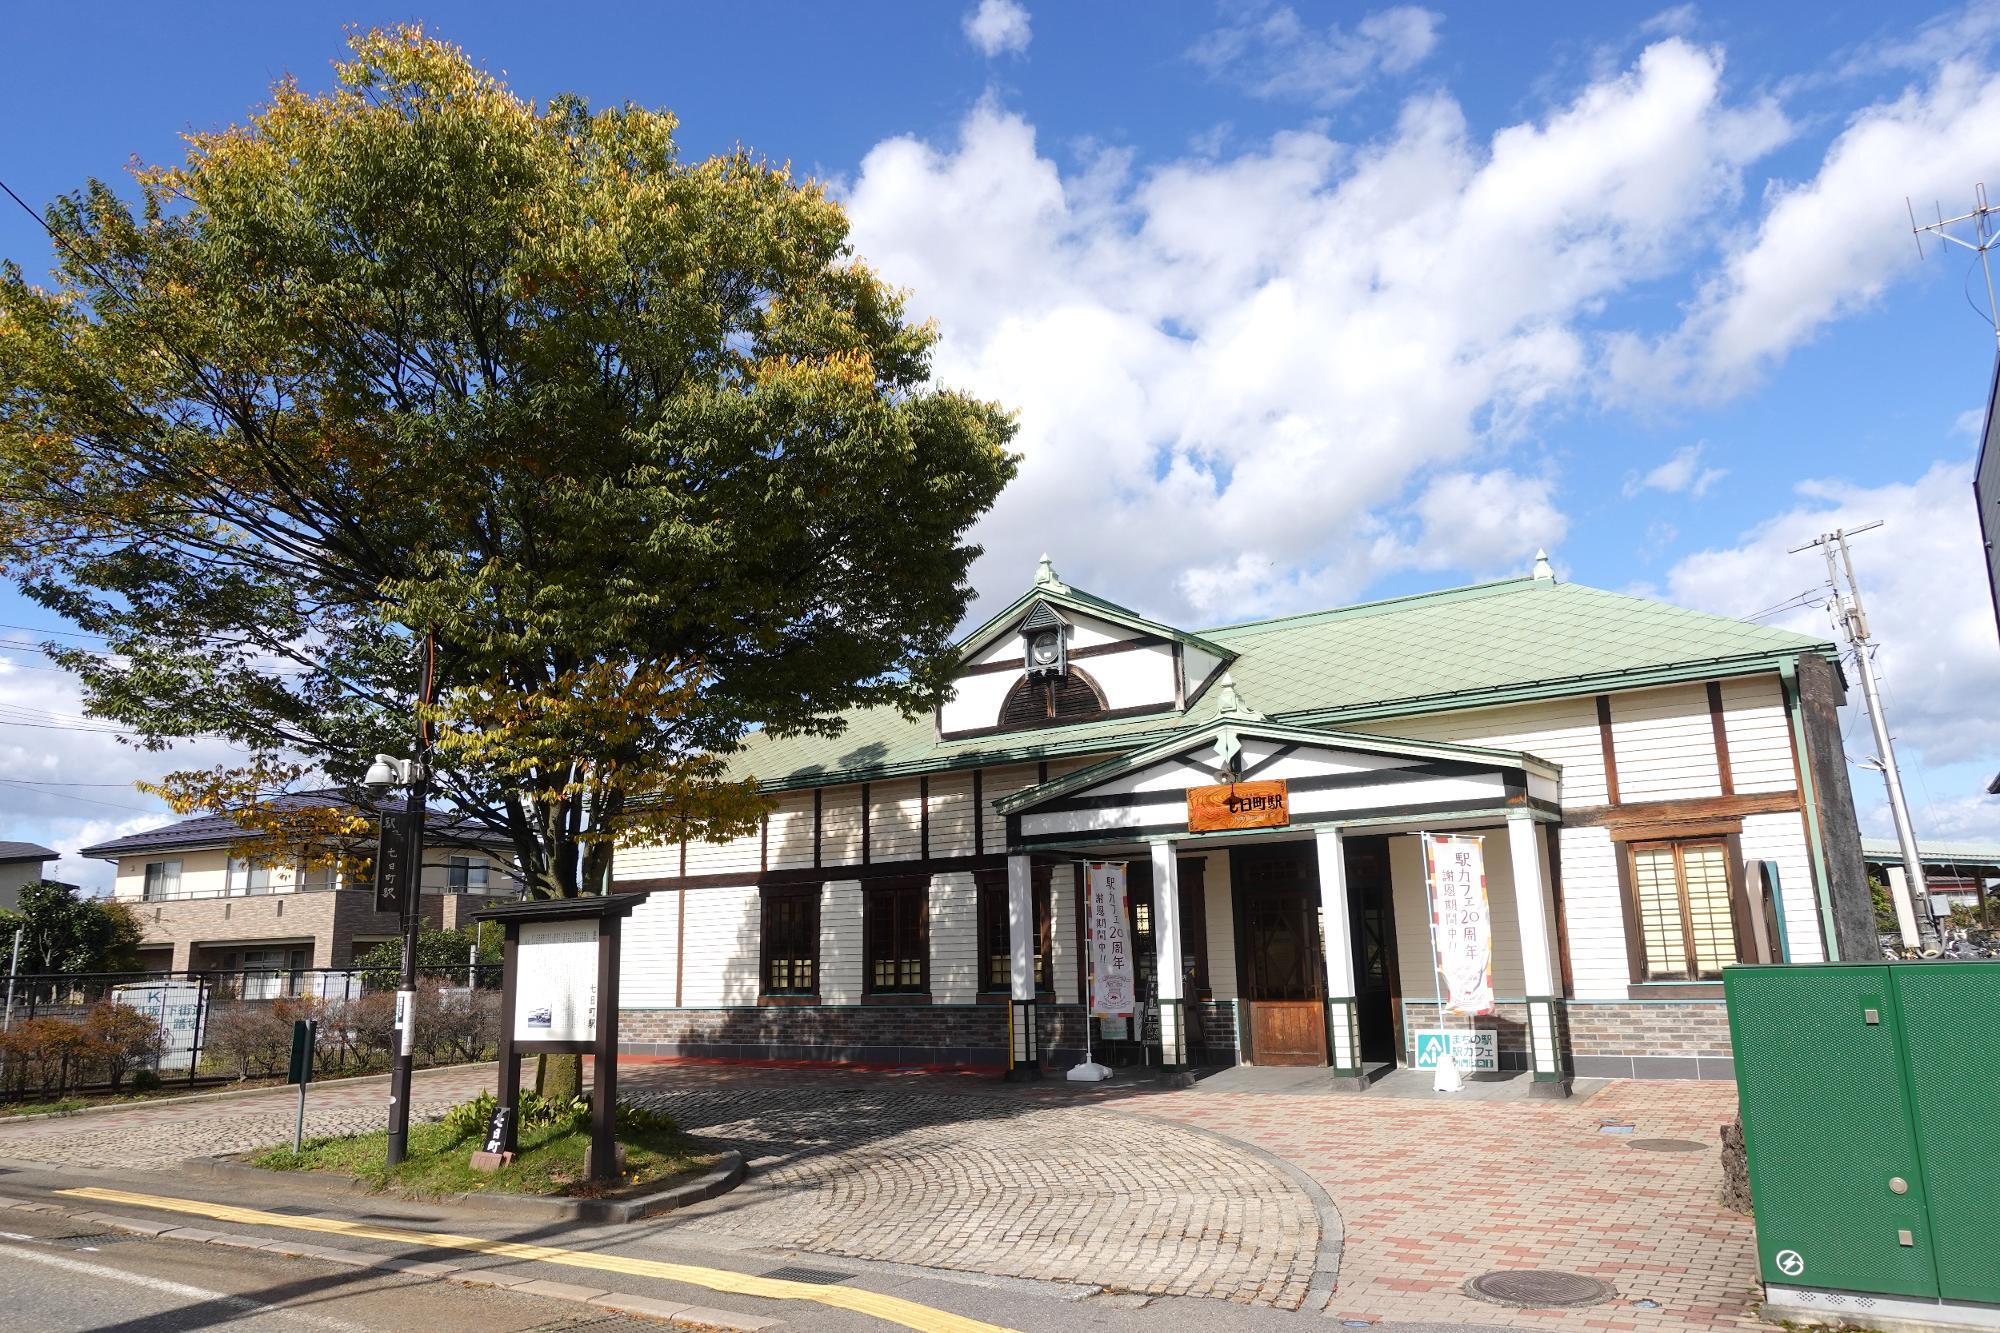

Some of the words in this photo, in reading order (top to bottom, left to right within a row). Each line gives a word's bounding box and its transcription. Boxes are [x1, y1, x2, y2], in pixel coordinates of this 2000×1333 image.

[1105, 876, 1125, 970] 駅カフェ20周年
[1455, 851, 1480, 960] 駅カフェ20周年
[1452, 1046, 1494, 1057] 駅カフェ
